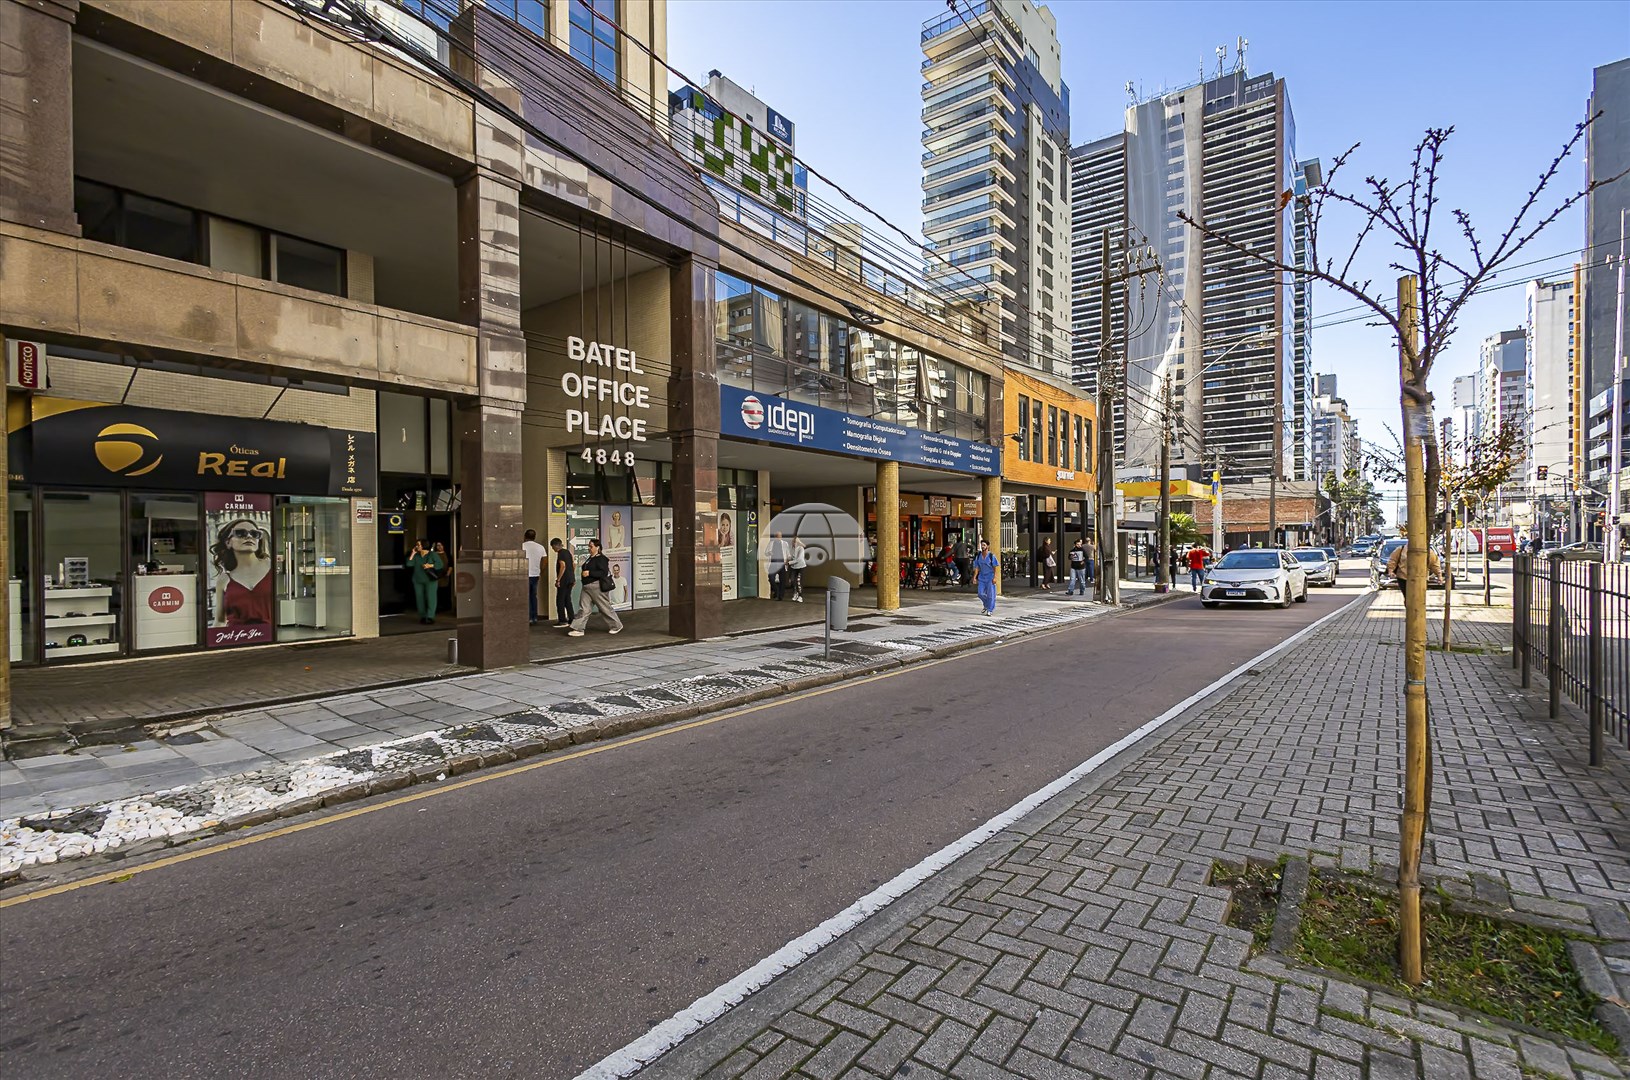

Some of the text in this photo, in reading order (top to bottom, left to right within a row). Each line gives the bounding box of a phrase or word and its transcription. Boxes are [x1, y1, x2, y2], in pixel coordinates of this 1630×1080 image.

[566, 336, 644, 374] BATEL
[561, 372, 650, 408] OFFICE
[566, 409, 647, 441] PLACE
[768, 402, 814, 442] idepi
[847, 417, 871, 428] Tomografia
[847, 430, 887, 443] Mamografia Digital
[230, 444, 259, 455] Óticas
[847, 443, 877, 454] Densitometria
[581, 448, 635, 467] 4848
[215, 630, 235, 643] Just
